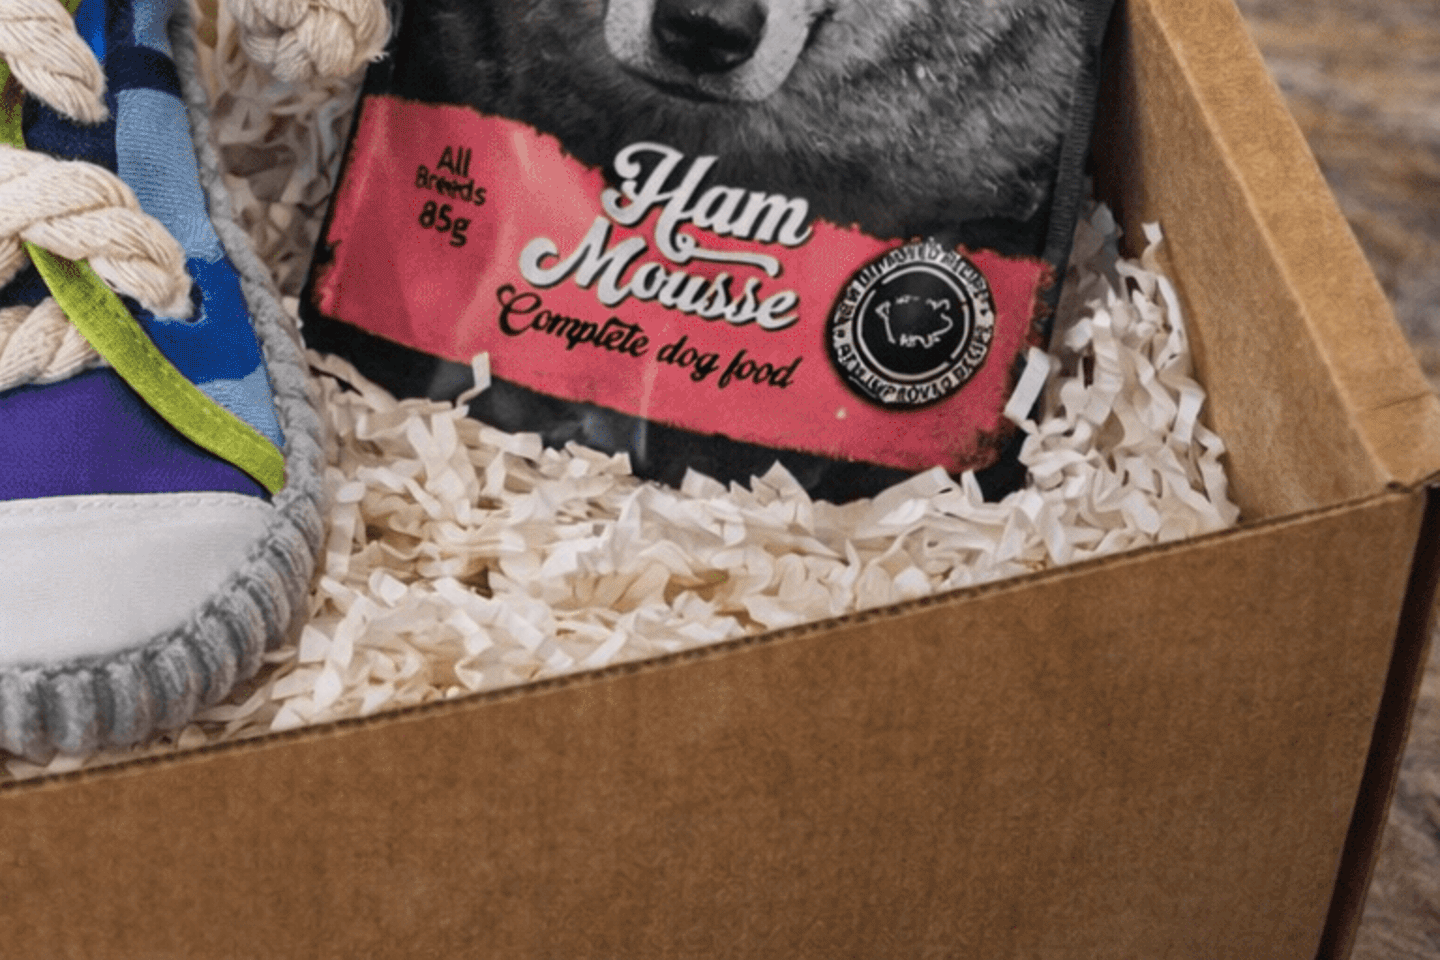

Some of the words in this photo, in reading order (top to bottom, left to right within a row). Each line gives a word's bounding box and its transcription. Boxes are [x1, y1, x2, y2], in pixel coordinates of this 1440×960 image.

[436, 145, 472, 178] All
[601, 142, 814, 264] Ham
[419, 200, 471, 248] 85g
[519, 216, 800, 333] Mousse
[496, 285, 650, 357] Complete
[656, 335, 720, 382] dog
[717, 349, 804, 389] food
